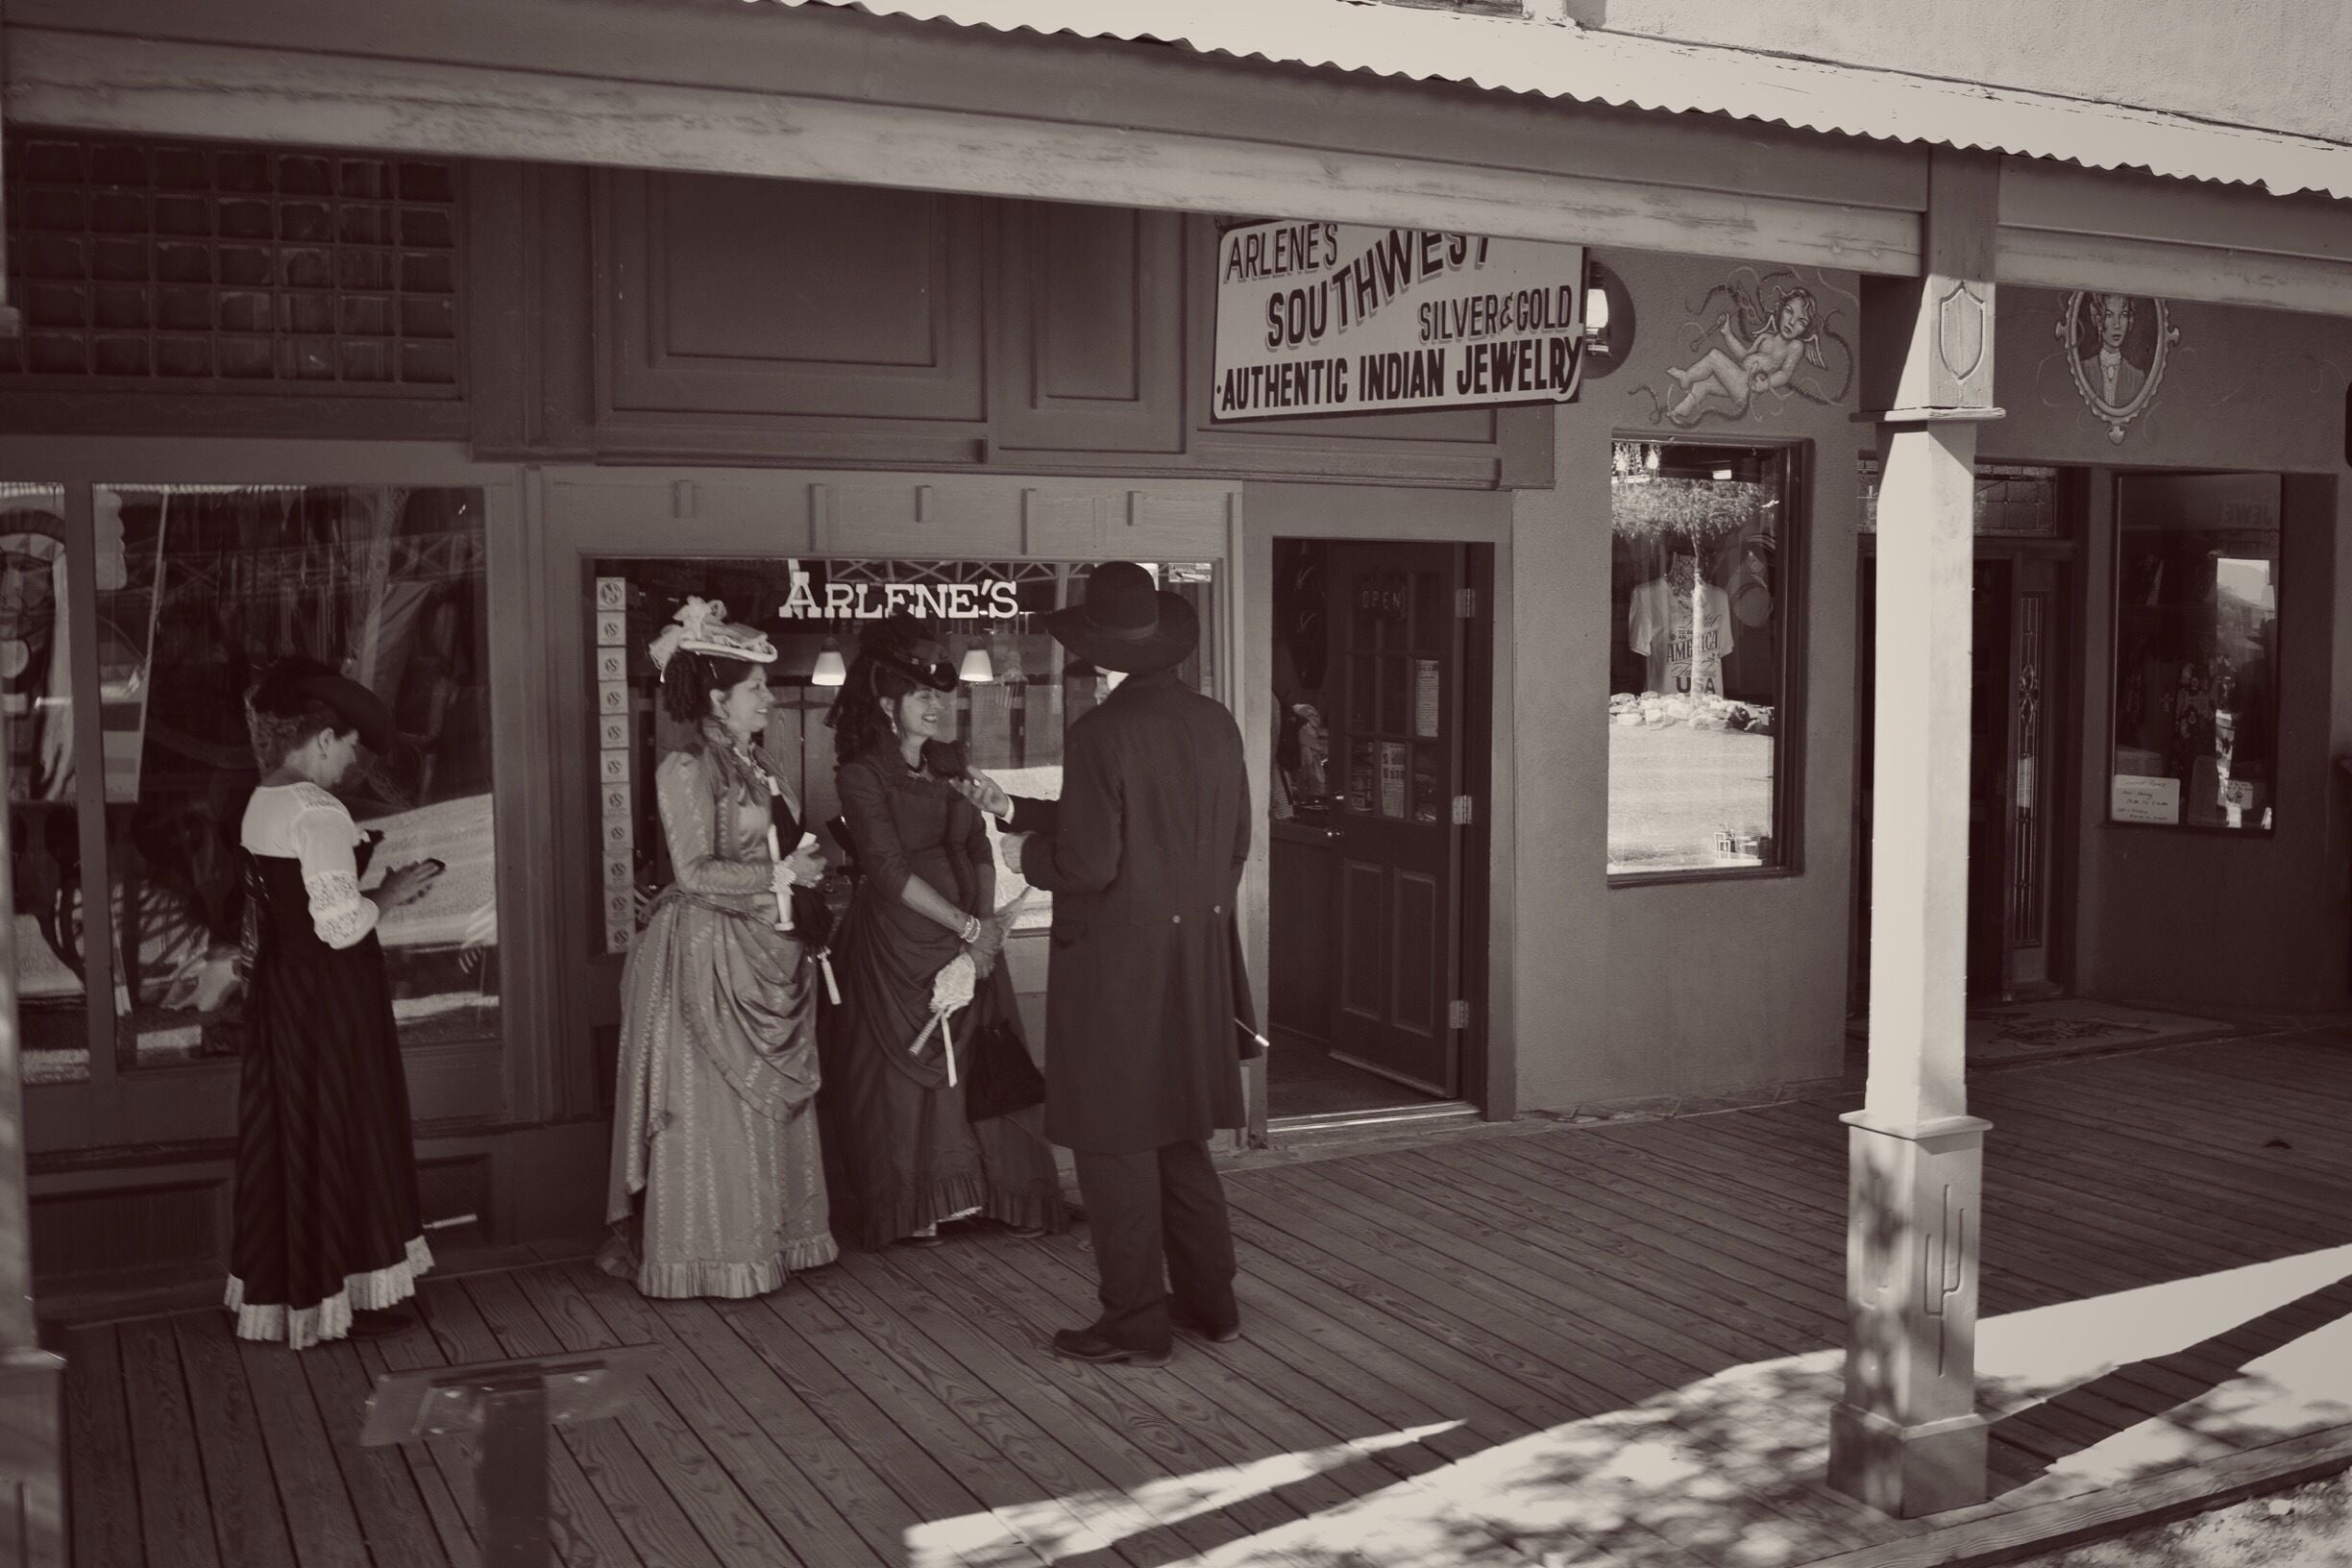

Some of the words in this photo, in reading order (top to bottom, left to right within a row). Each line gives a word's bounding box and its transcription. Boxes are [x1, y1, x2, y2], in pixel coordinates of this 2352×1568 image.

[1225, 222, 1340, 282] ARLENE'S
[1220, 356, 1348, 412] AUTHENTIC
[1358, 347, 1446, 403] INDIAN
[1456, 334, 1584, 397] JEWELRY
[1361, 589, 1401, 610] OPEN
